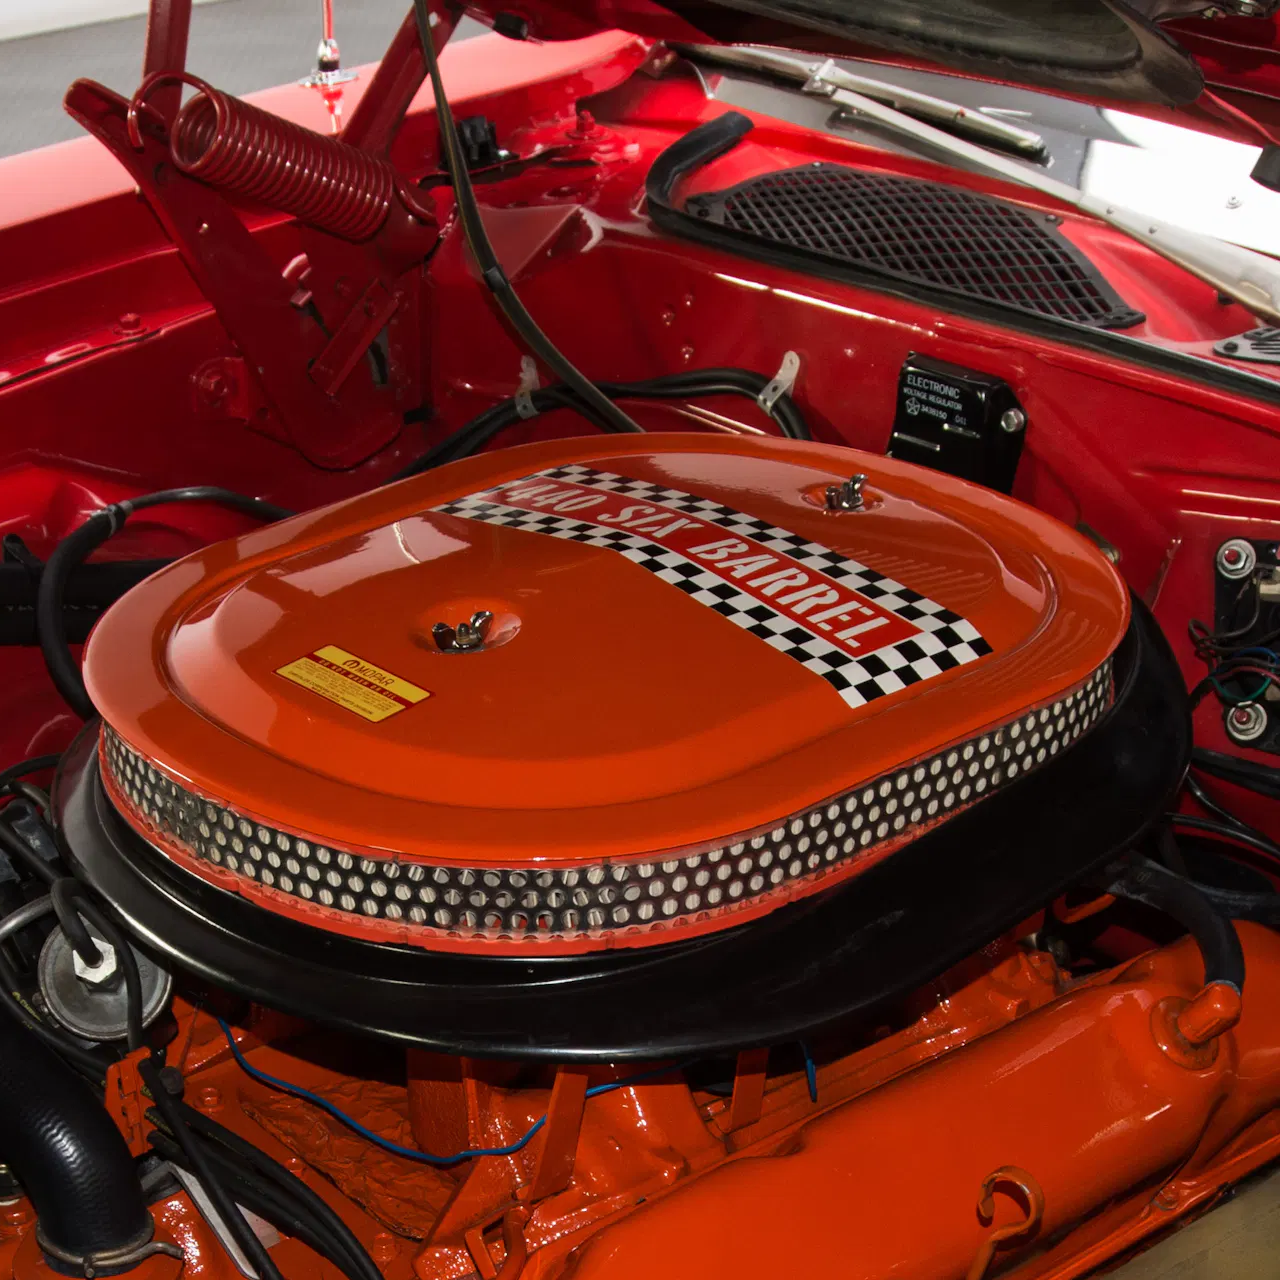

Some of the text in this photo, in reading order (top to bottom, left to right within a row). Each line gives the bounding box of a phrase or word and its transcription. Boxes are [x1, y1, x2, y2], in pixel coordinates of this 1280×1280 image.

[907, 374, 960, 399] ELECTRONIC
[928, 394, 962, 411] REGULATOR
[505, 476, 889, 648] 440 SIX BARREL
[356, 666, 395, 686] MOPAR
